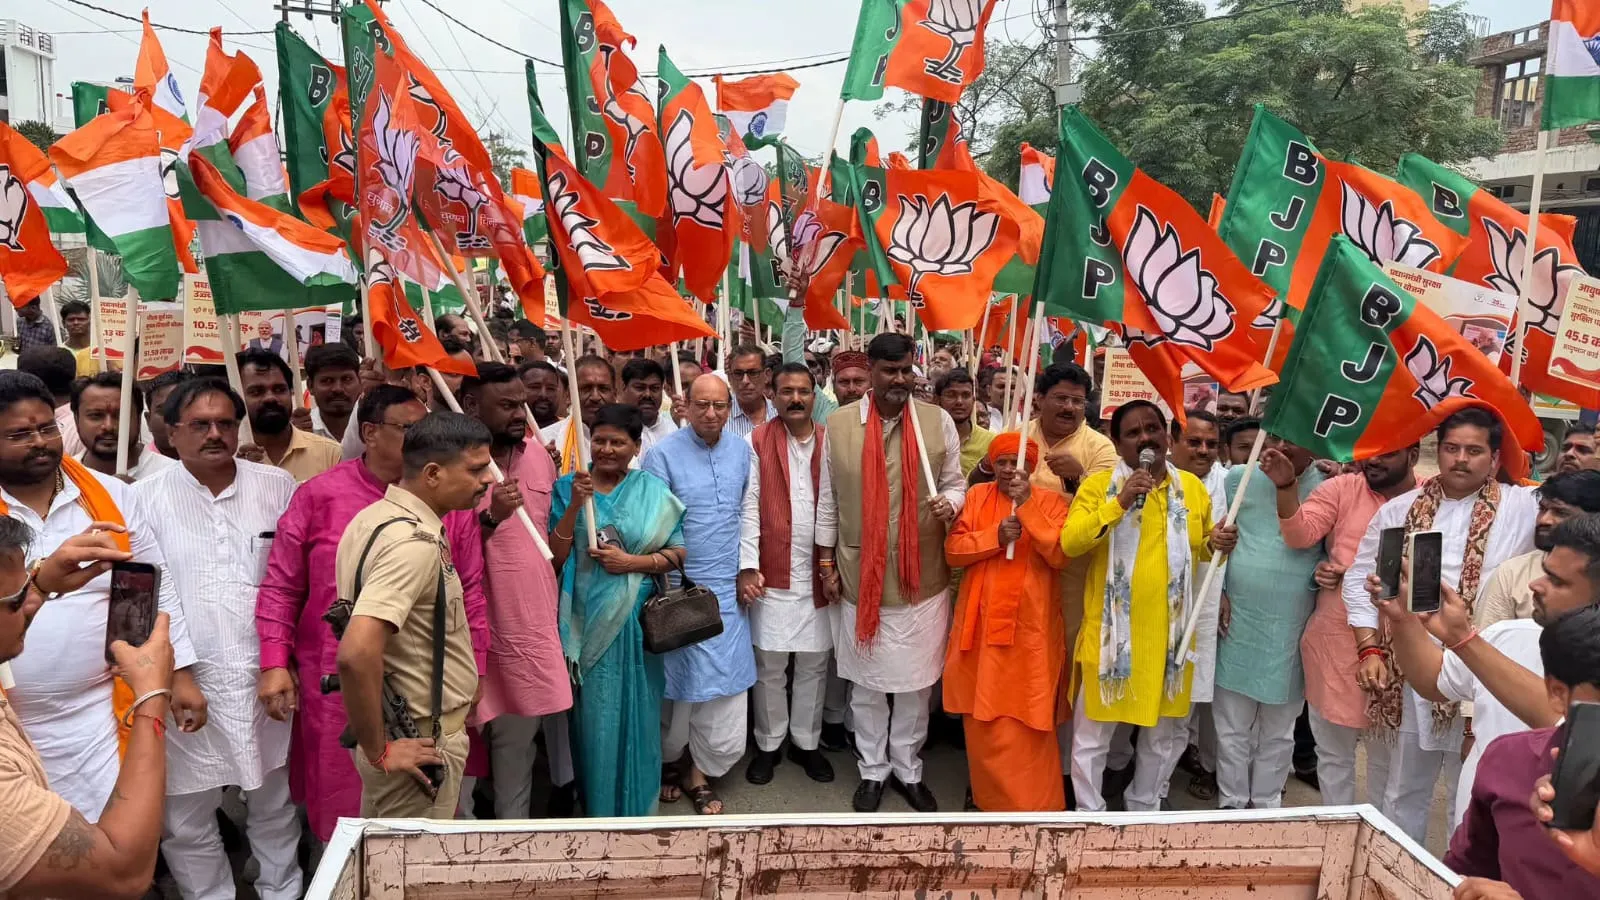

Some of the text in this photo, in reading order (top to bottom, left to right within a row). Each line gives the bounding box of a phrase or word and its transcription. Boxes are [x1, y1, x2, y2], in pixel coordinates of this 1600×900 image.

[1081, 156, 1118, 299] BJP
[1250, 139, 1320, 276] BJP
[1389, 268, 1442, 289] प्रधानमंत्री सुरक्षा
[1403, 283, 1426, 295] योजना
[1312, 281, 1402, 439] BJP
[1565, 328, 1589, 345] 45.5
